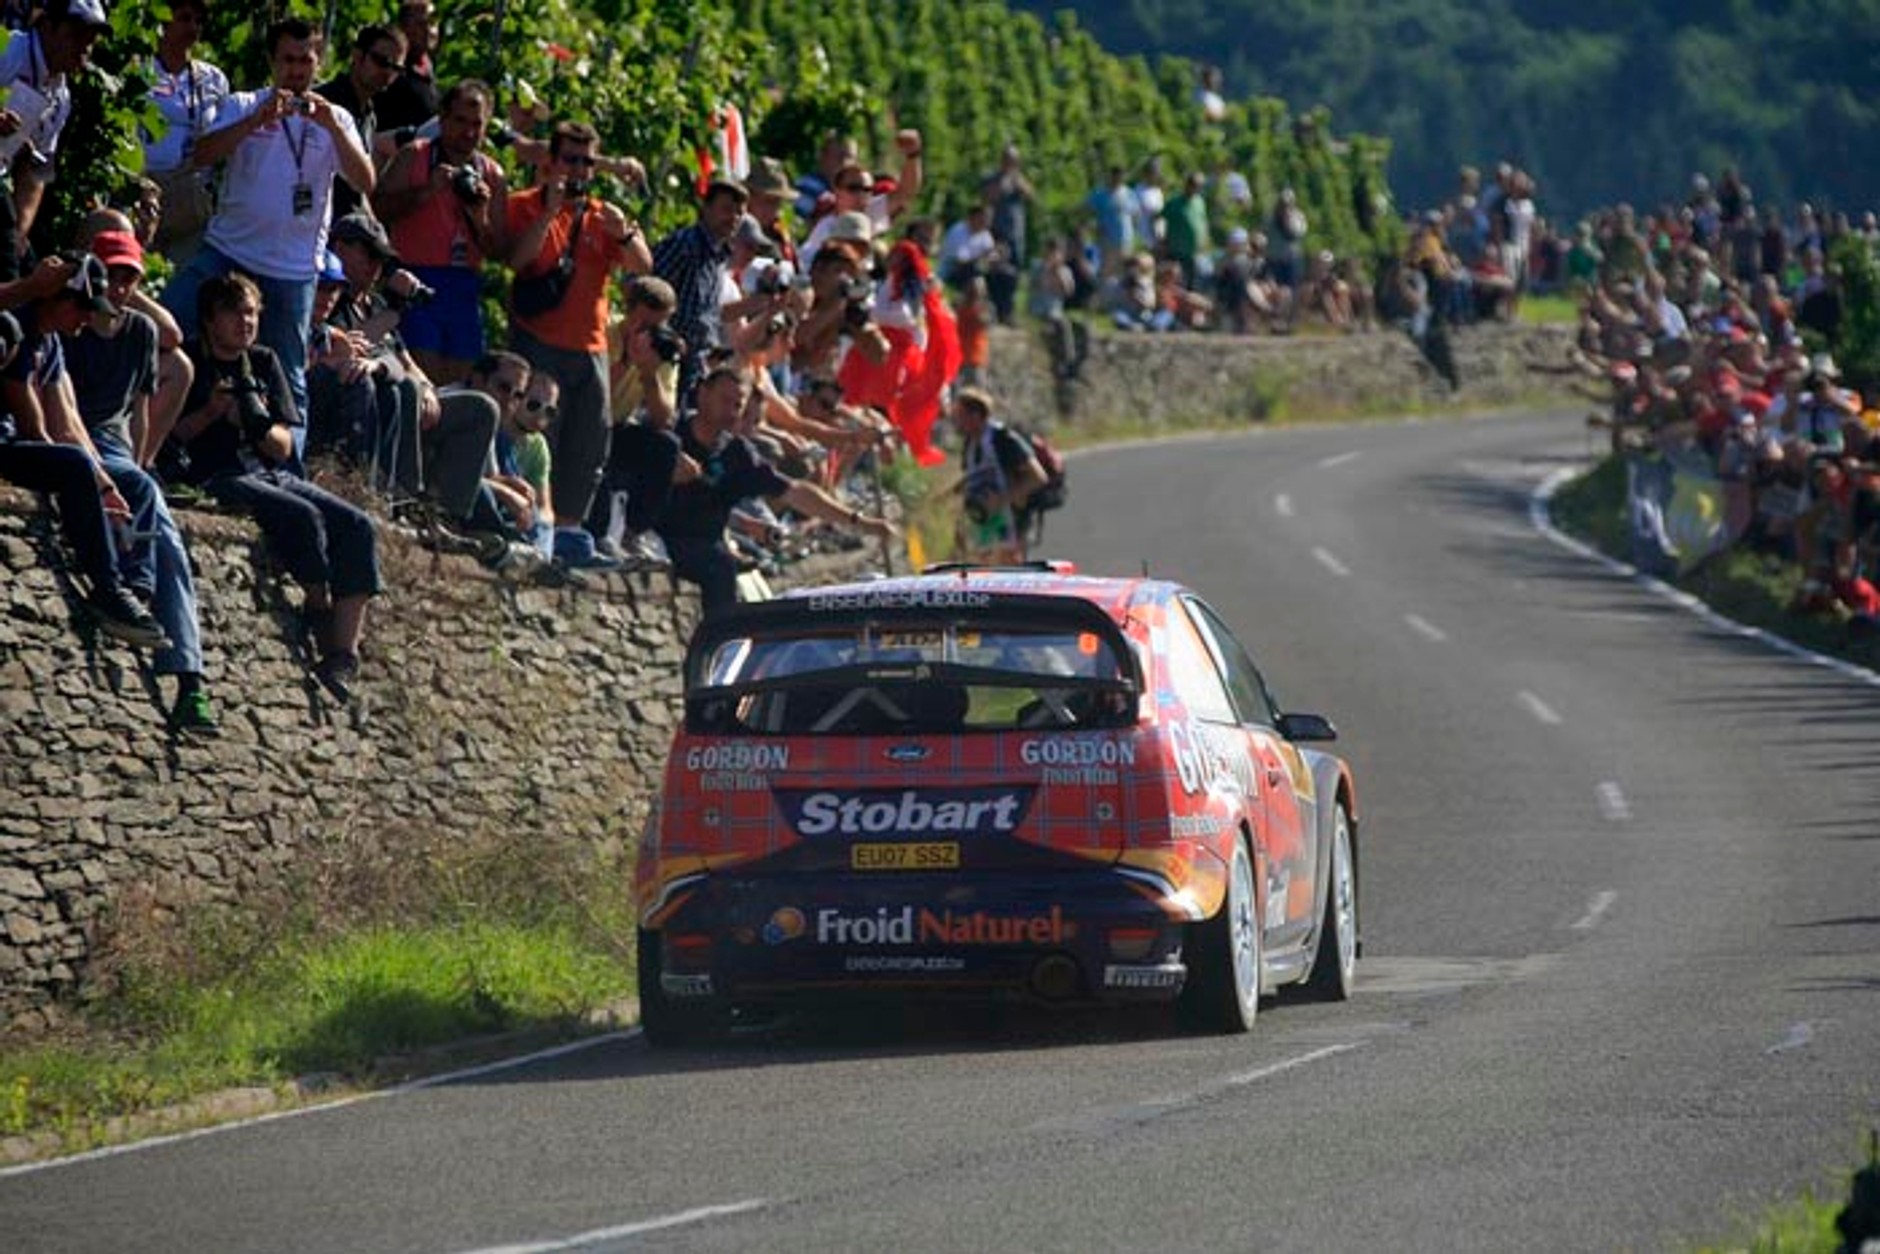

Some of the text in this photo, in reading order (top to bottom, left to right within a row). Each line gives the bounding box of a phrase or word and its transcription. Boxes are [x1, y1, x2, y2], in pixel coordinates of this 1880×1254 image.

[687, 745, 789, 770] GORDON
[1020, 740, 1135, 765] GORDON
[797, 791, 1019, 834] Stobart
[856, 845, 955, 866] EU07 SSZ
[816, 905, 1062, 944] Froid Naturel
